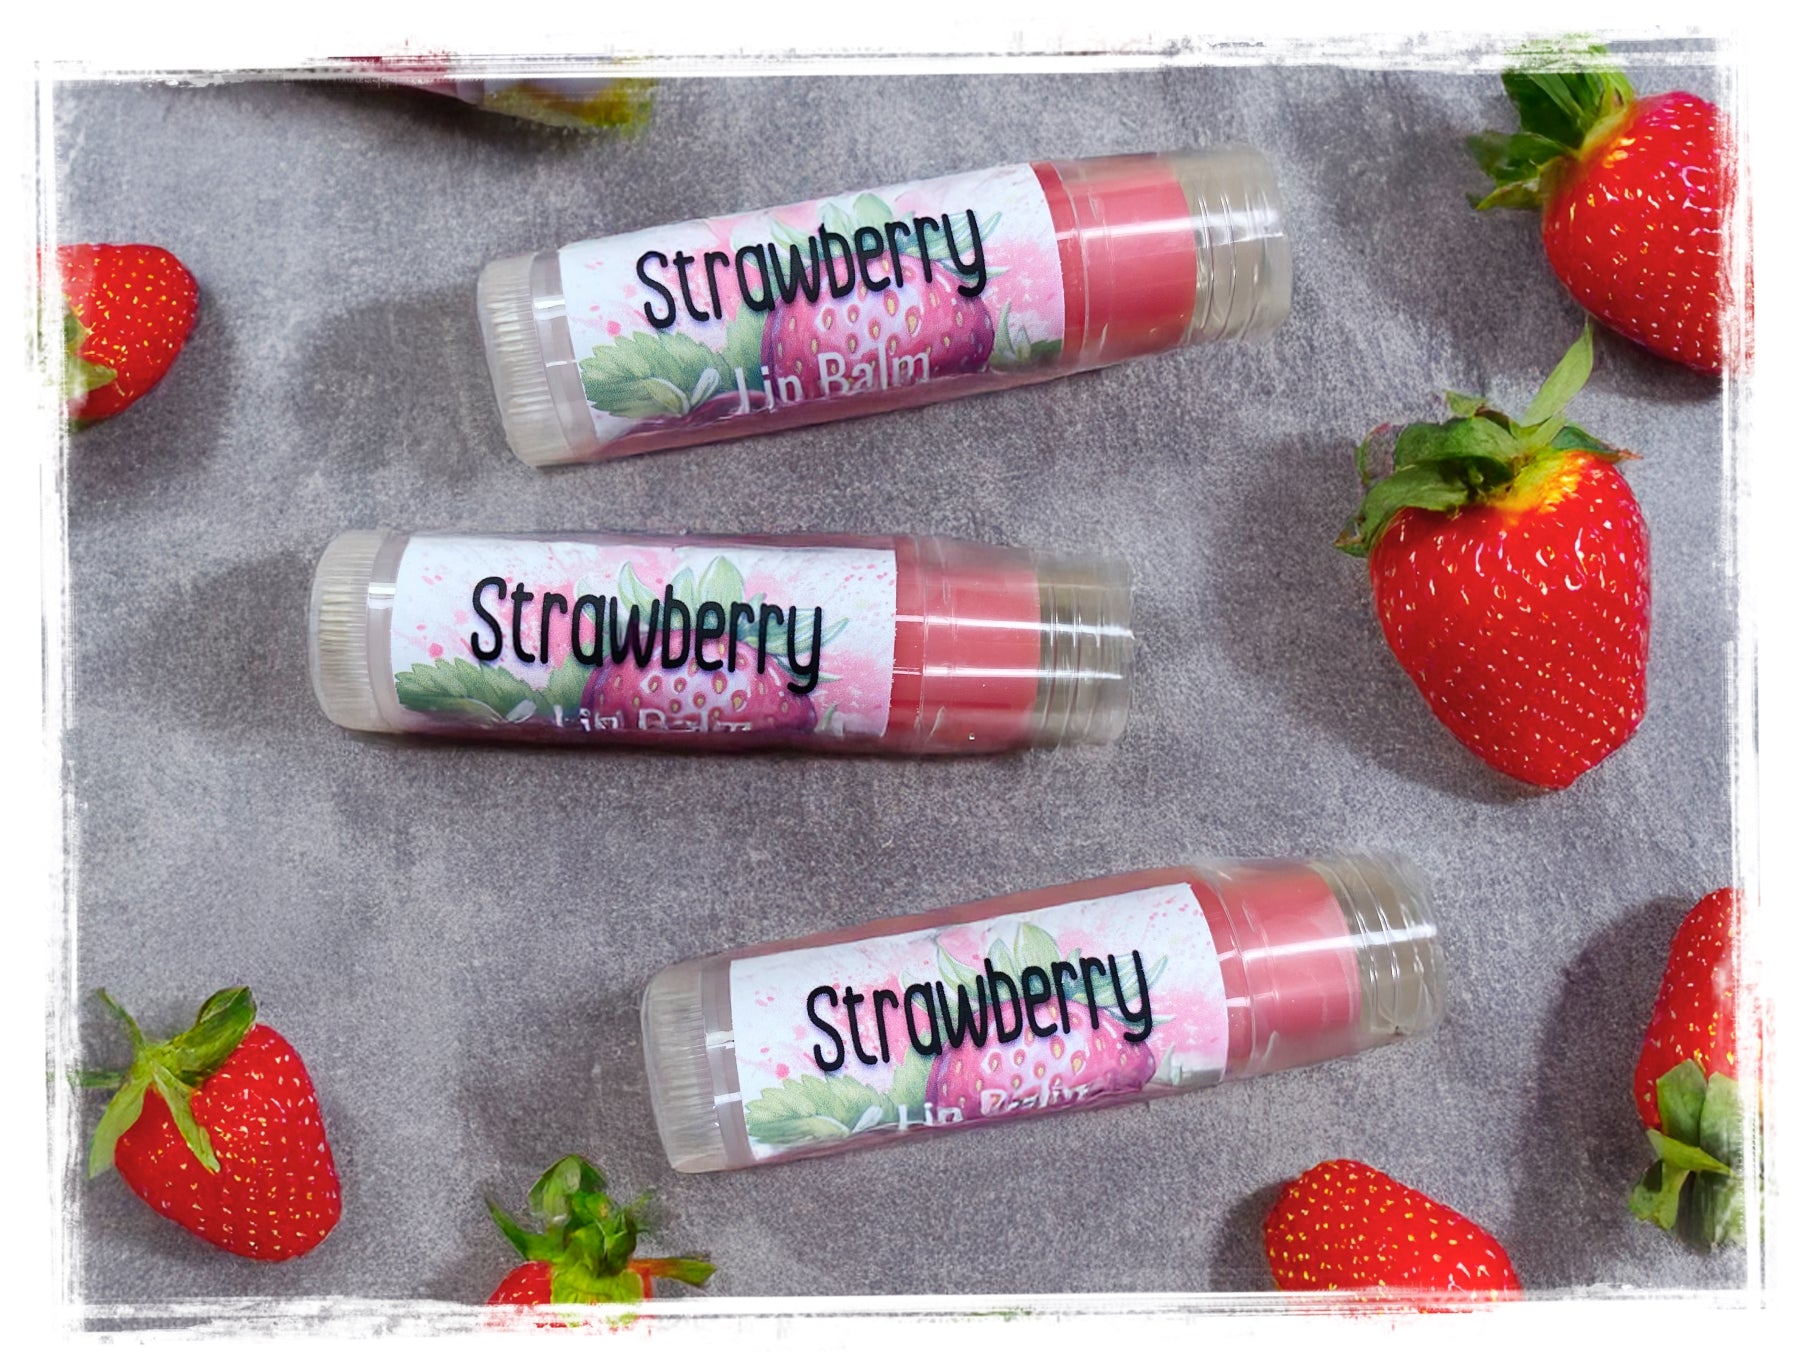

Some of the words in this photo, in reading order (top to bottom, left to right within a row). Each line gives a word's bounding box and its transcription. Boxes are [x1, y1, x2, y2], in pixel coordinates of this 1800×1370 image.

[635, 208, 986, 329] Strawberry
[817, 344, 931, 400] Balm
[470, 576, 822, 694] Strawberry
[805, 949, 1154, 1072] Strawberry
